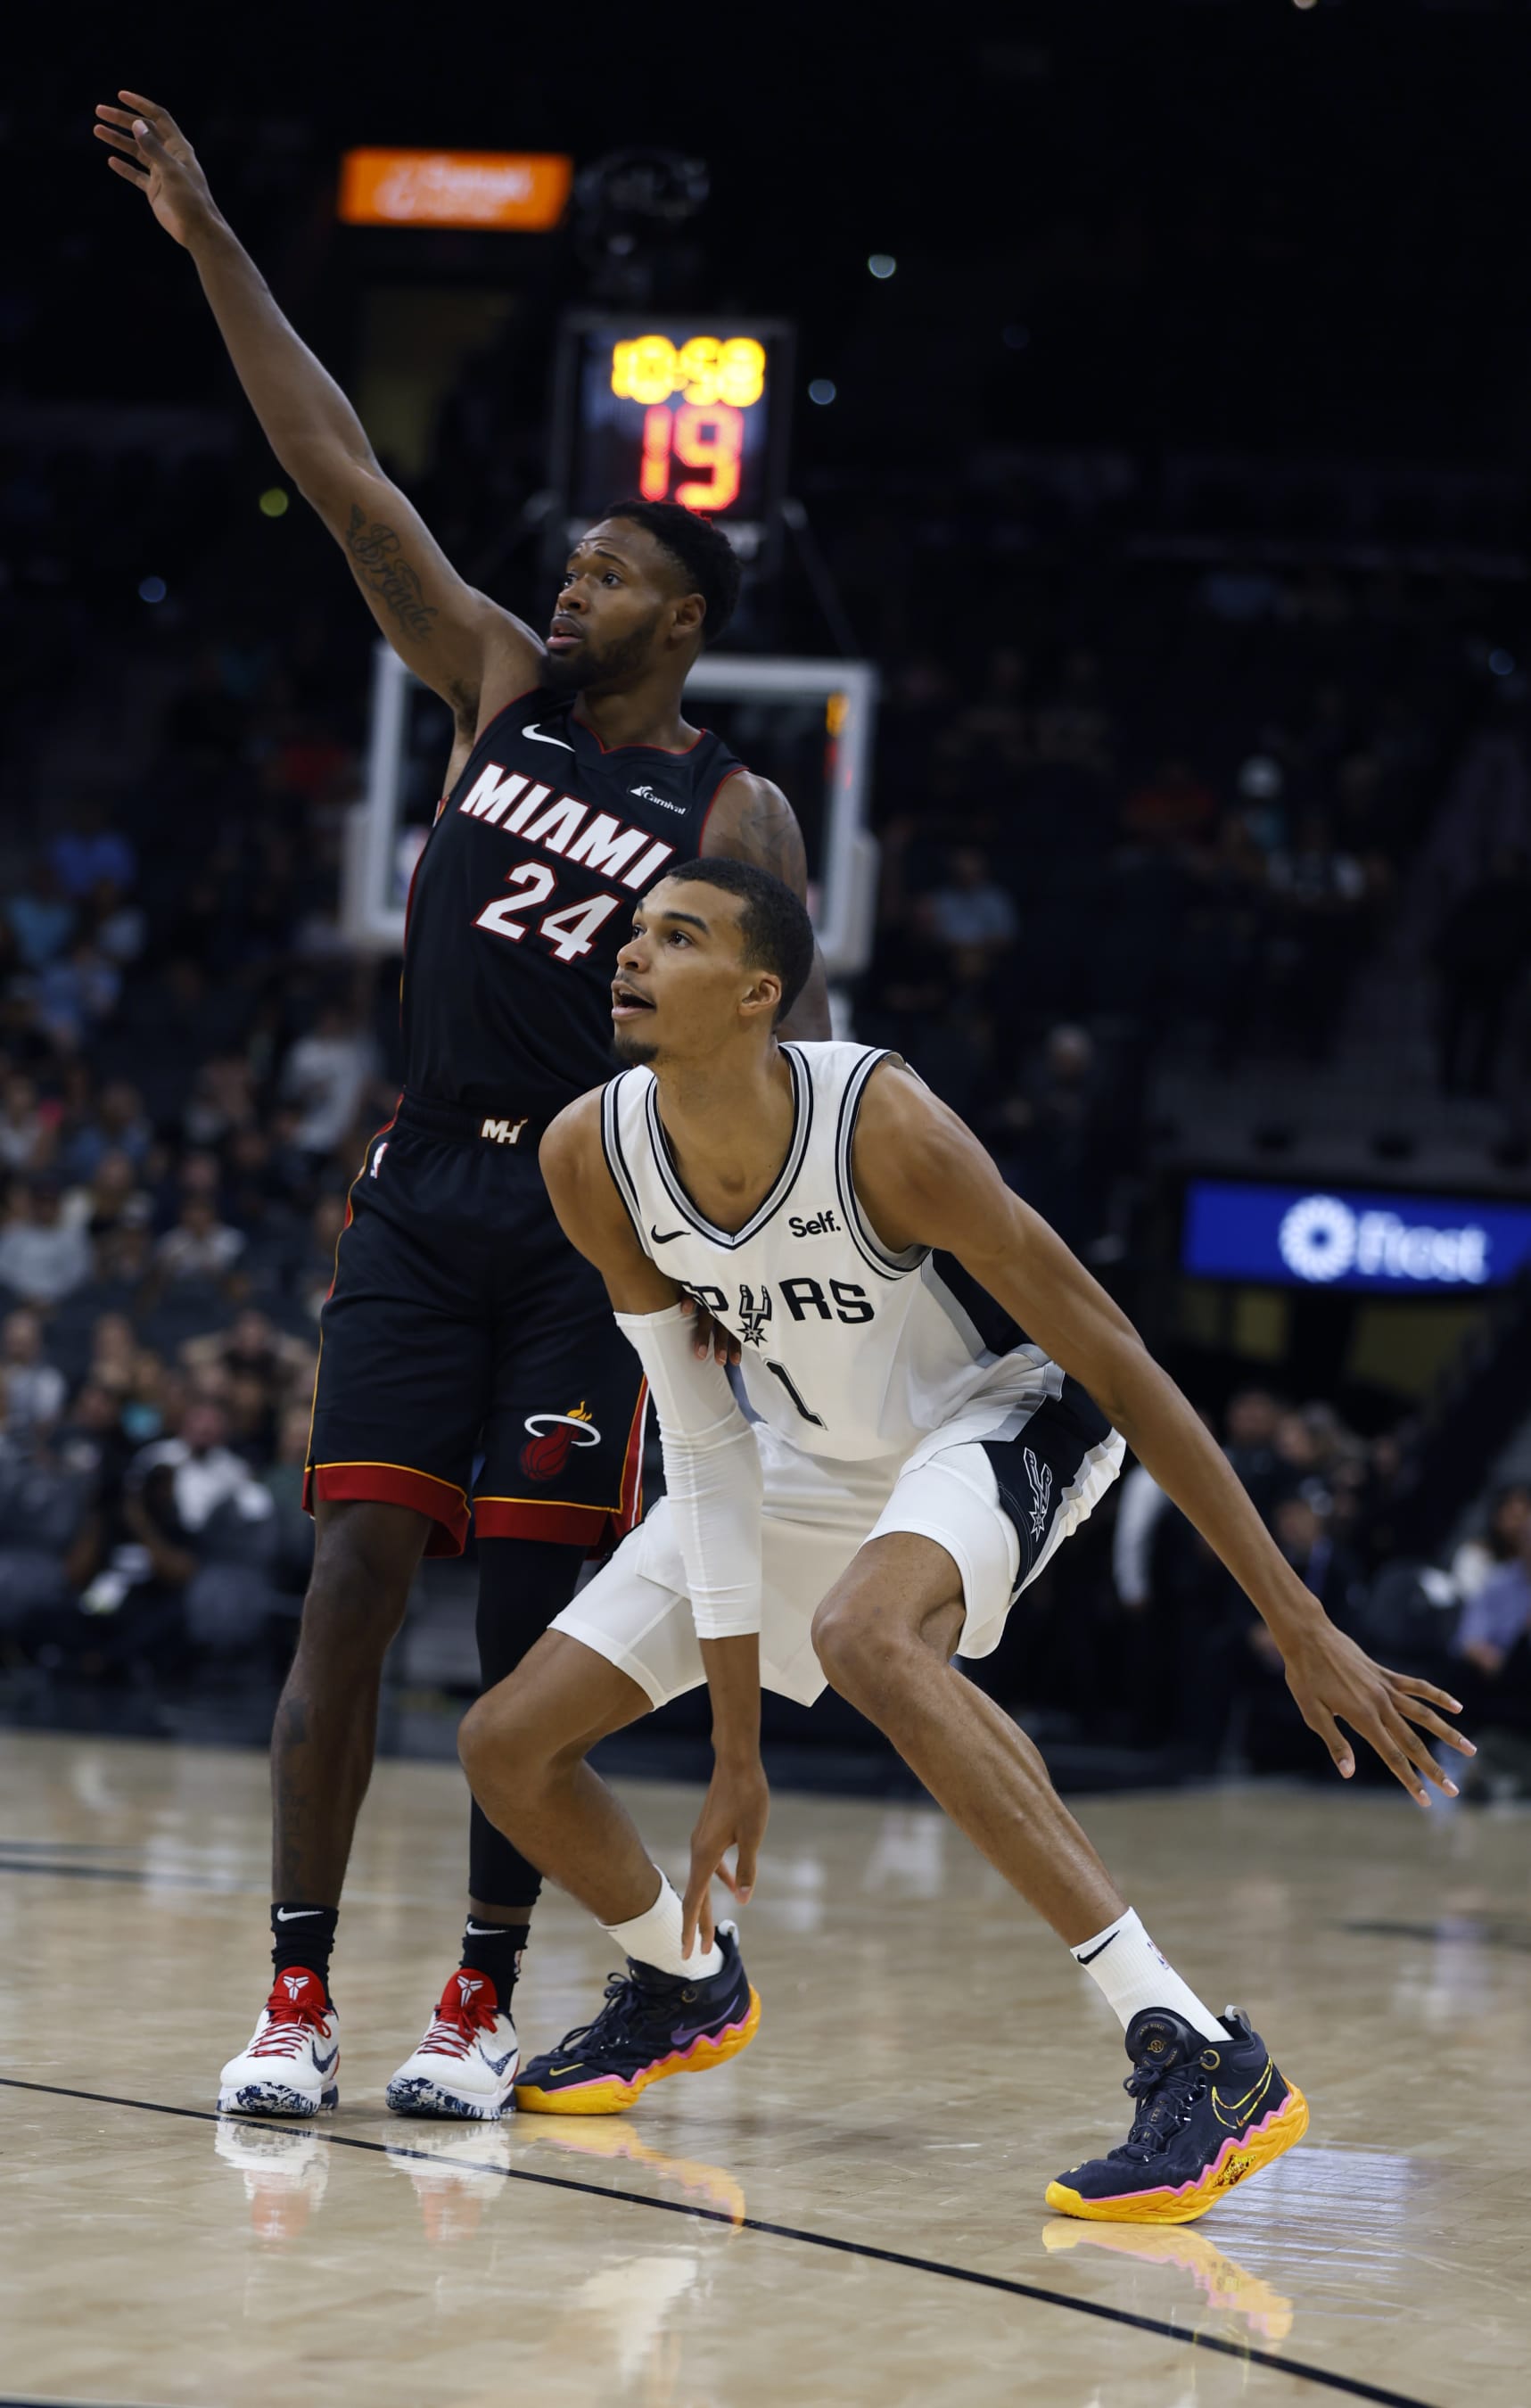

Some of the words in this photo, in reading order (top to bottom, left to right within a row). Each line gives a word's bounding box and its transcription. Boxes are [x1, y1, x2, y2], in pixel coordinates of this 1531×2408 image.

[639, 404, 745, 510] 19
[457, 760, 677, 893] MIAMI
[643, 789, 687, 815] Carnival
[471, 858, 624, 965] 24
[788, 1210, 841, 1238] Self.
[763, 1357, 827, 1431] 1
